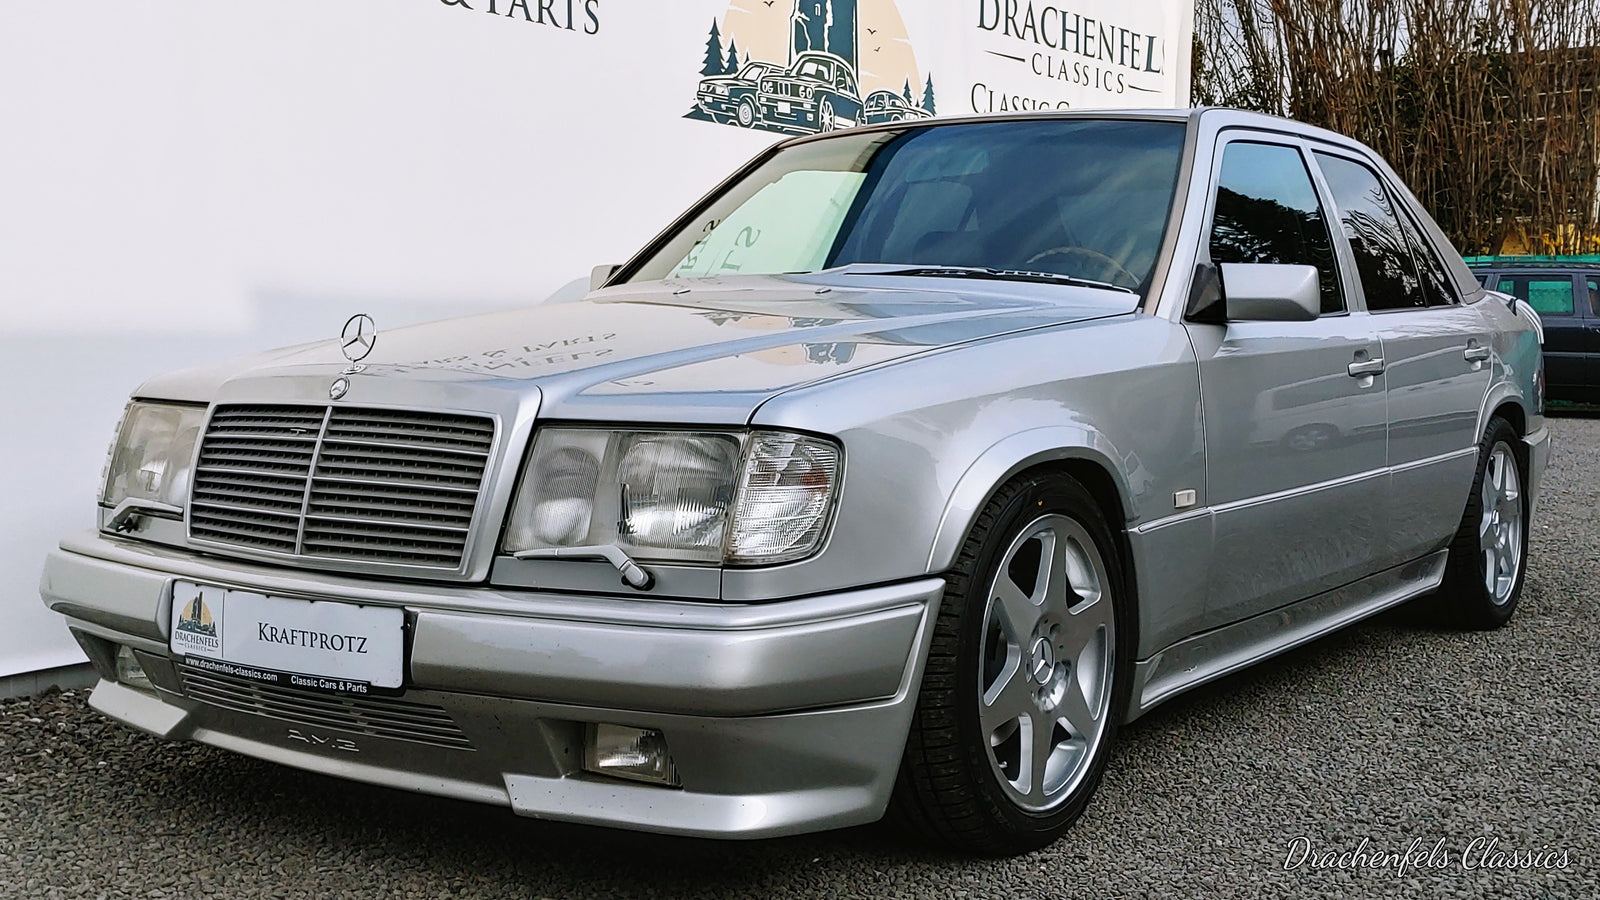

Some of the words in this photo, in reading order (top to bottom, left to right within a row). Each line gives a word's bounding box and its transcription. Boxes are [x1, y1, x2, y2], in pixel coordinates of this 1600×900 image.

[977, 0, 1166, 76] DRACHENFEL
[1031, 52, 1124, 94] CLASSICS
[174, 631, 219, 648] DRACHENFELS
[258, 622, 368, 653] KRAFTPROTZ
[185, 657, 278, 681] www.drachenfels-classics.com
[290, 675, 318, 687] Classic
[319, 679, 337, 690] Cars
[338, 681, 345, 691] &
[346, 682, 368, 693] Parts
